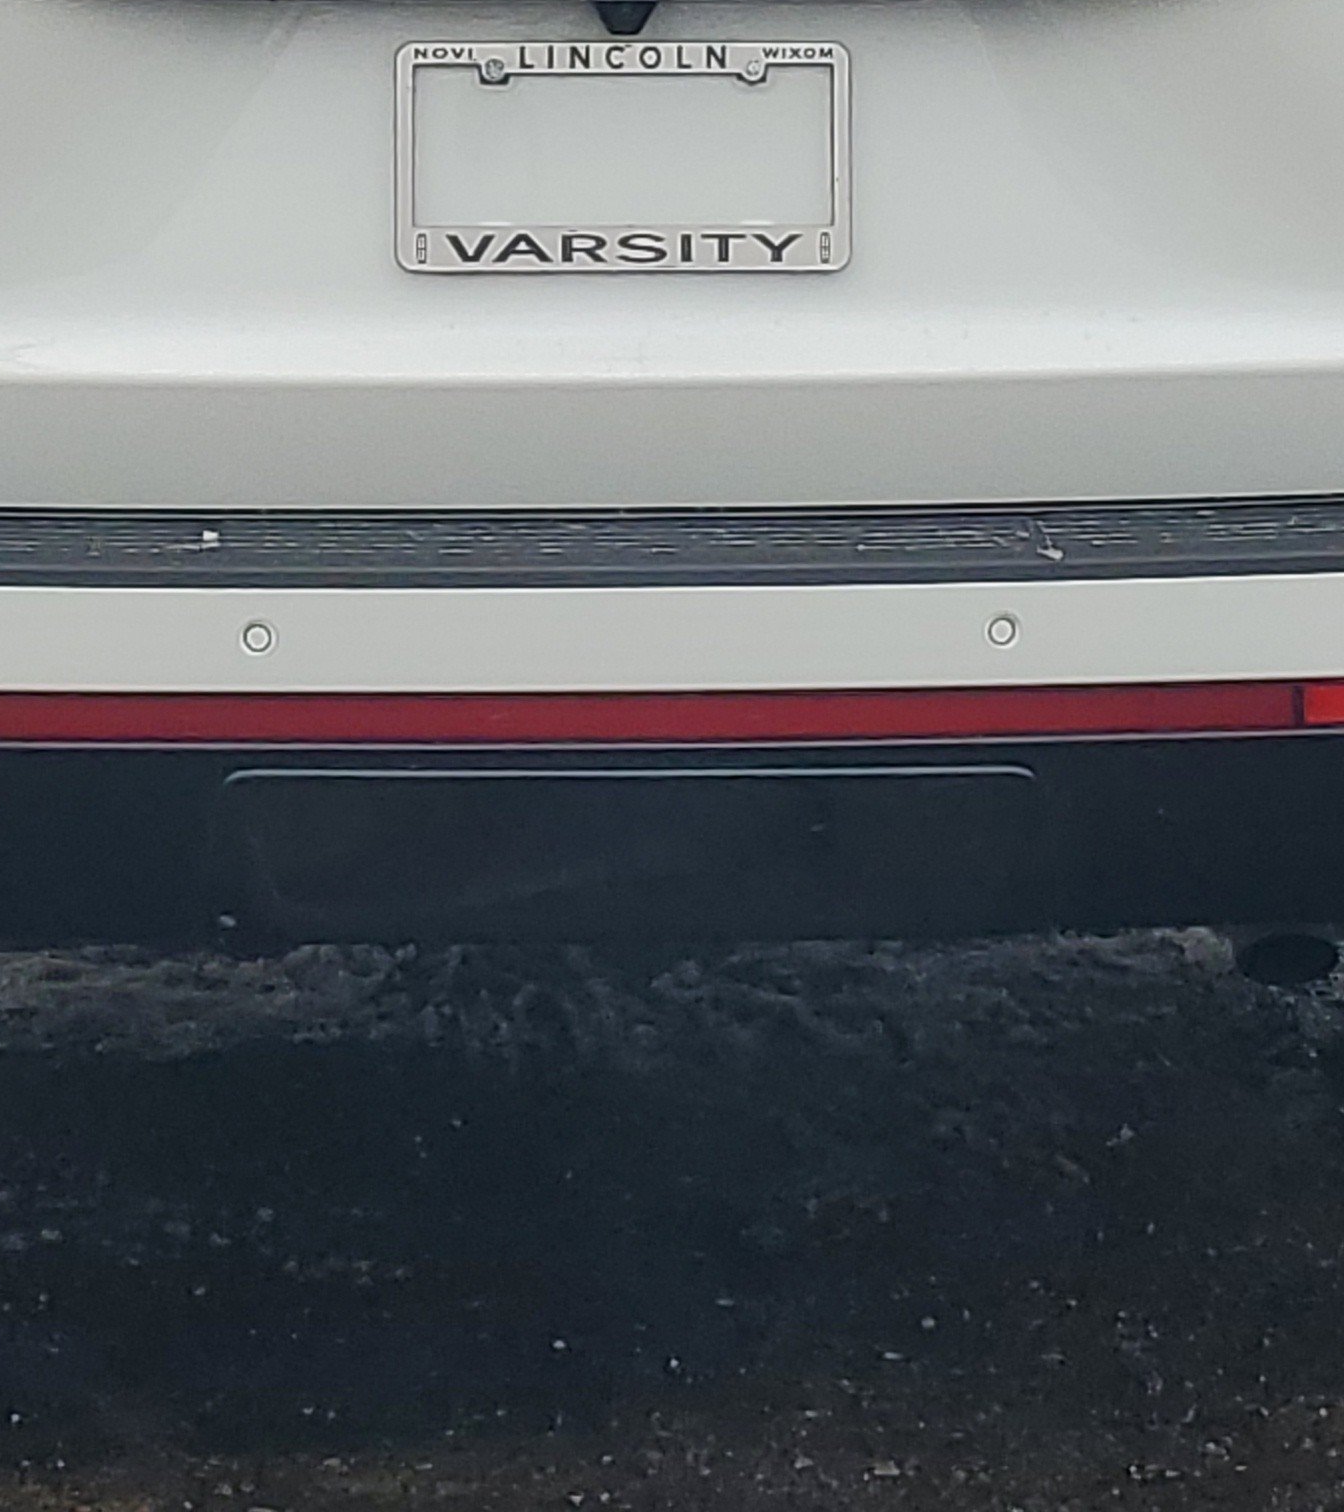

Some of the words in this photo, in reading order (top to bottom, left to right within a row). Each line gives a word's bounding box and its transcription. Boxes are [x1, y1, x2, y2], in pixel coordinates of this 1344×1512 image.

[414, 47, 474, 60] NOVI
[519, 44, 727, 70] LINCOLN
[762, 46, 834, 59] WIXOM
[445, 233, 804, 264] VARSITY
